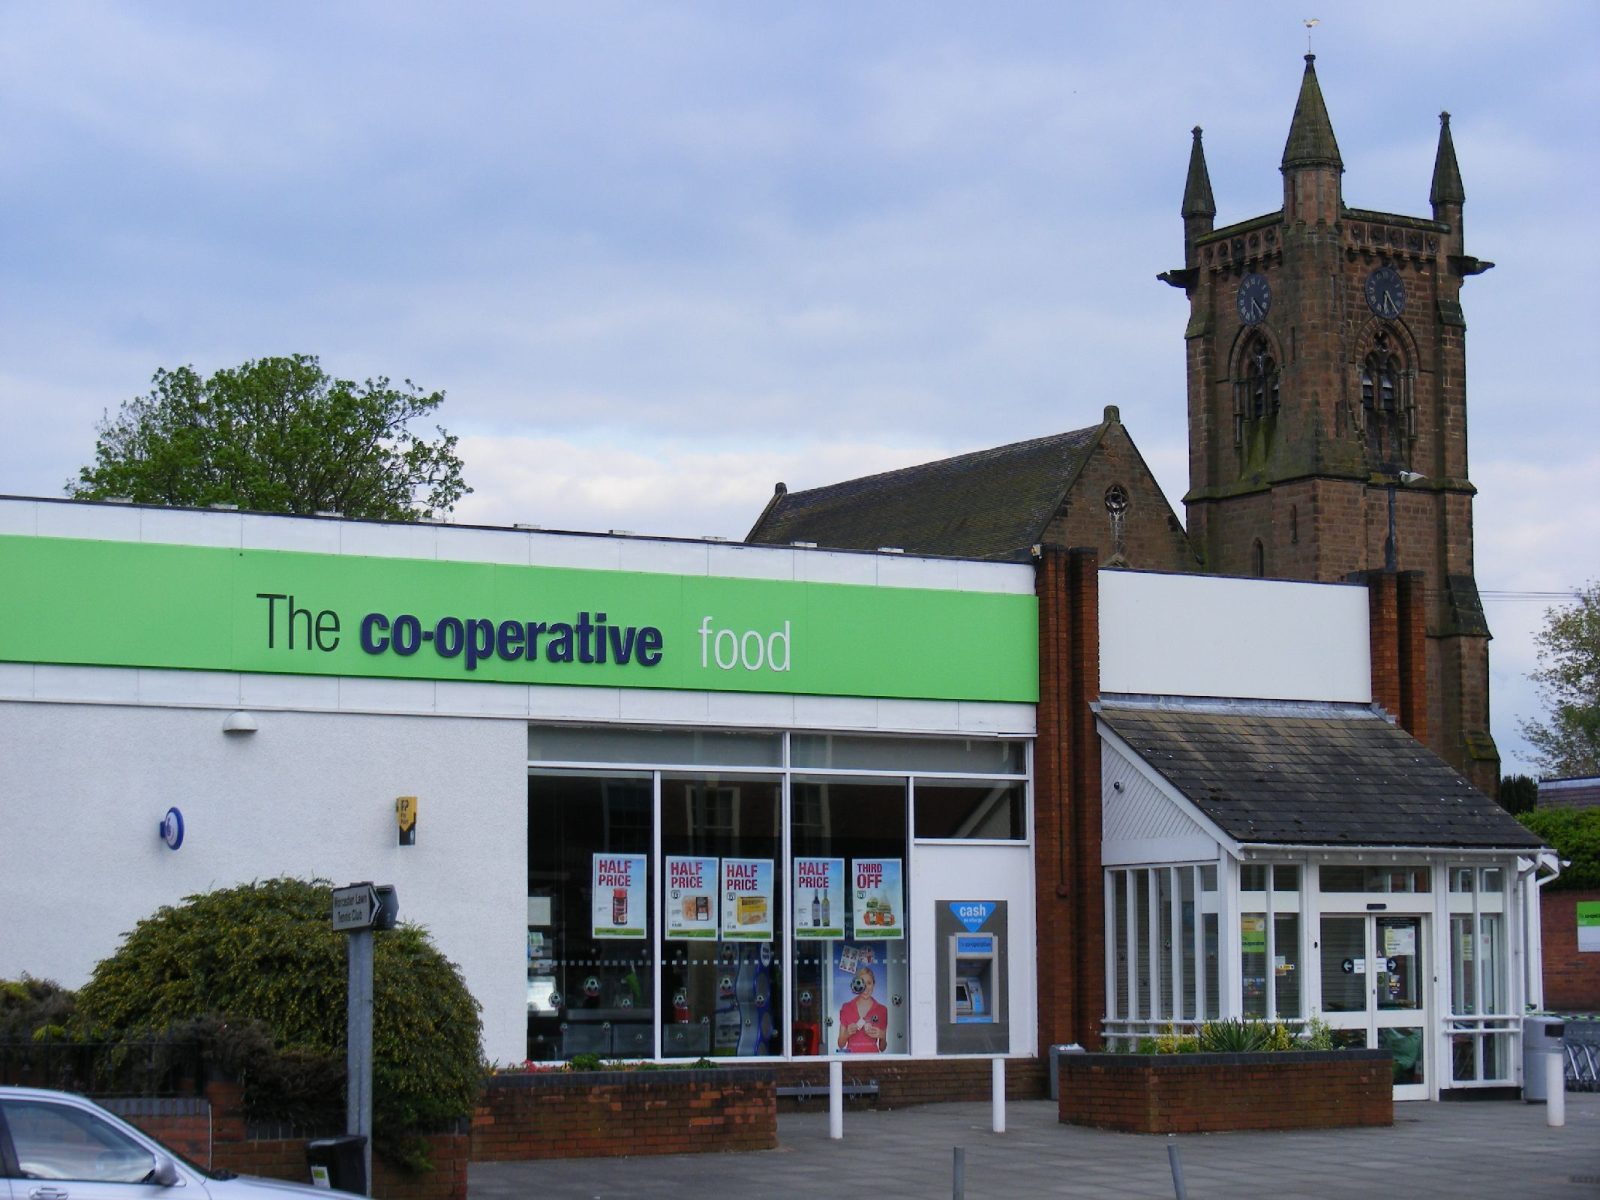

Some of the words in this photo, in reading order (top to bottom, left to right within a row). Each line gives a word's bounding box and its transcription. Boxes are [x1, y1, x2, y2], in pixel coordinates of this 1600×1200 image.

[256, 593, 341, 653] The
[360, 612, 664, 671] co-operative
[698, 616, 792, 673] food
[598, 860, 632, 874] HALF
[670, 862, 703, 876] HALF
[726, 864, 758, 878] HALF
[798, 862, 829, 876] HALF
[857, 863, 883, 874] THIRD
[598, 875, 632, 887] PRICE
[671, 876, 703, 889] PRICE
[726, 879, 758, 891] PRICE
[799, 876, 829, 889] PRICE
[857, 874, 883, 889] OFF
[959, 904, 986, 917] cash
